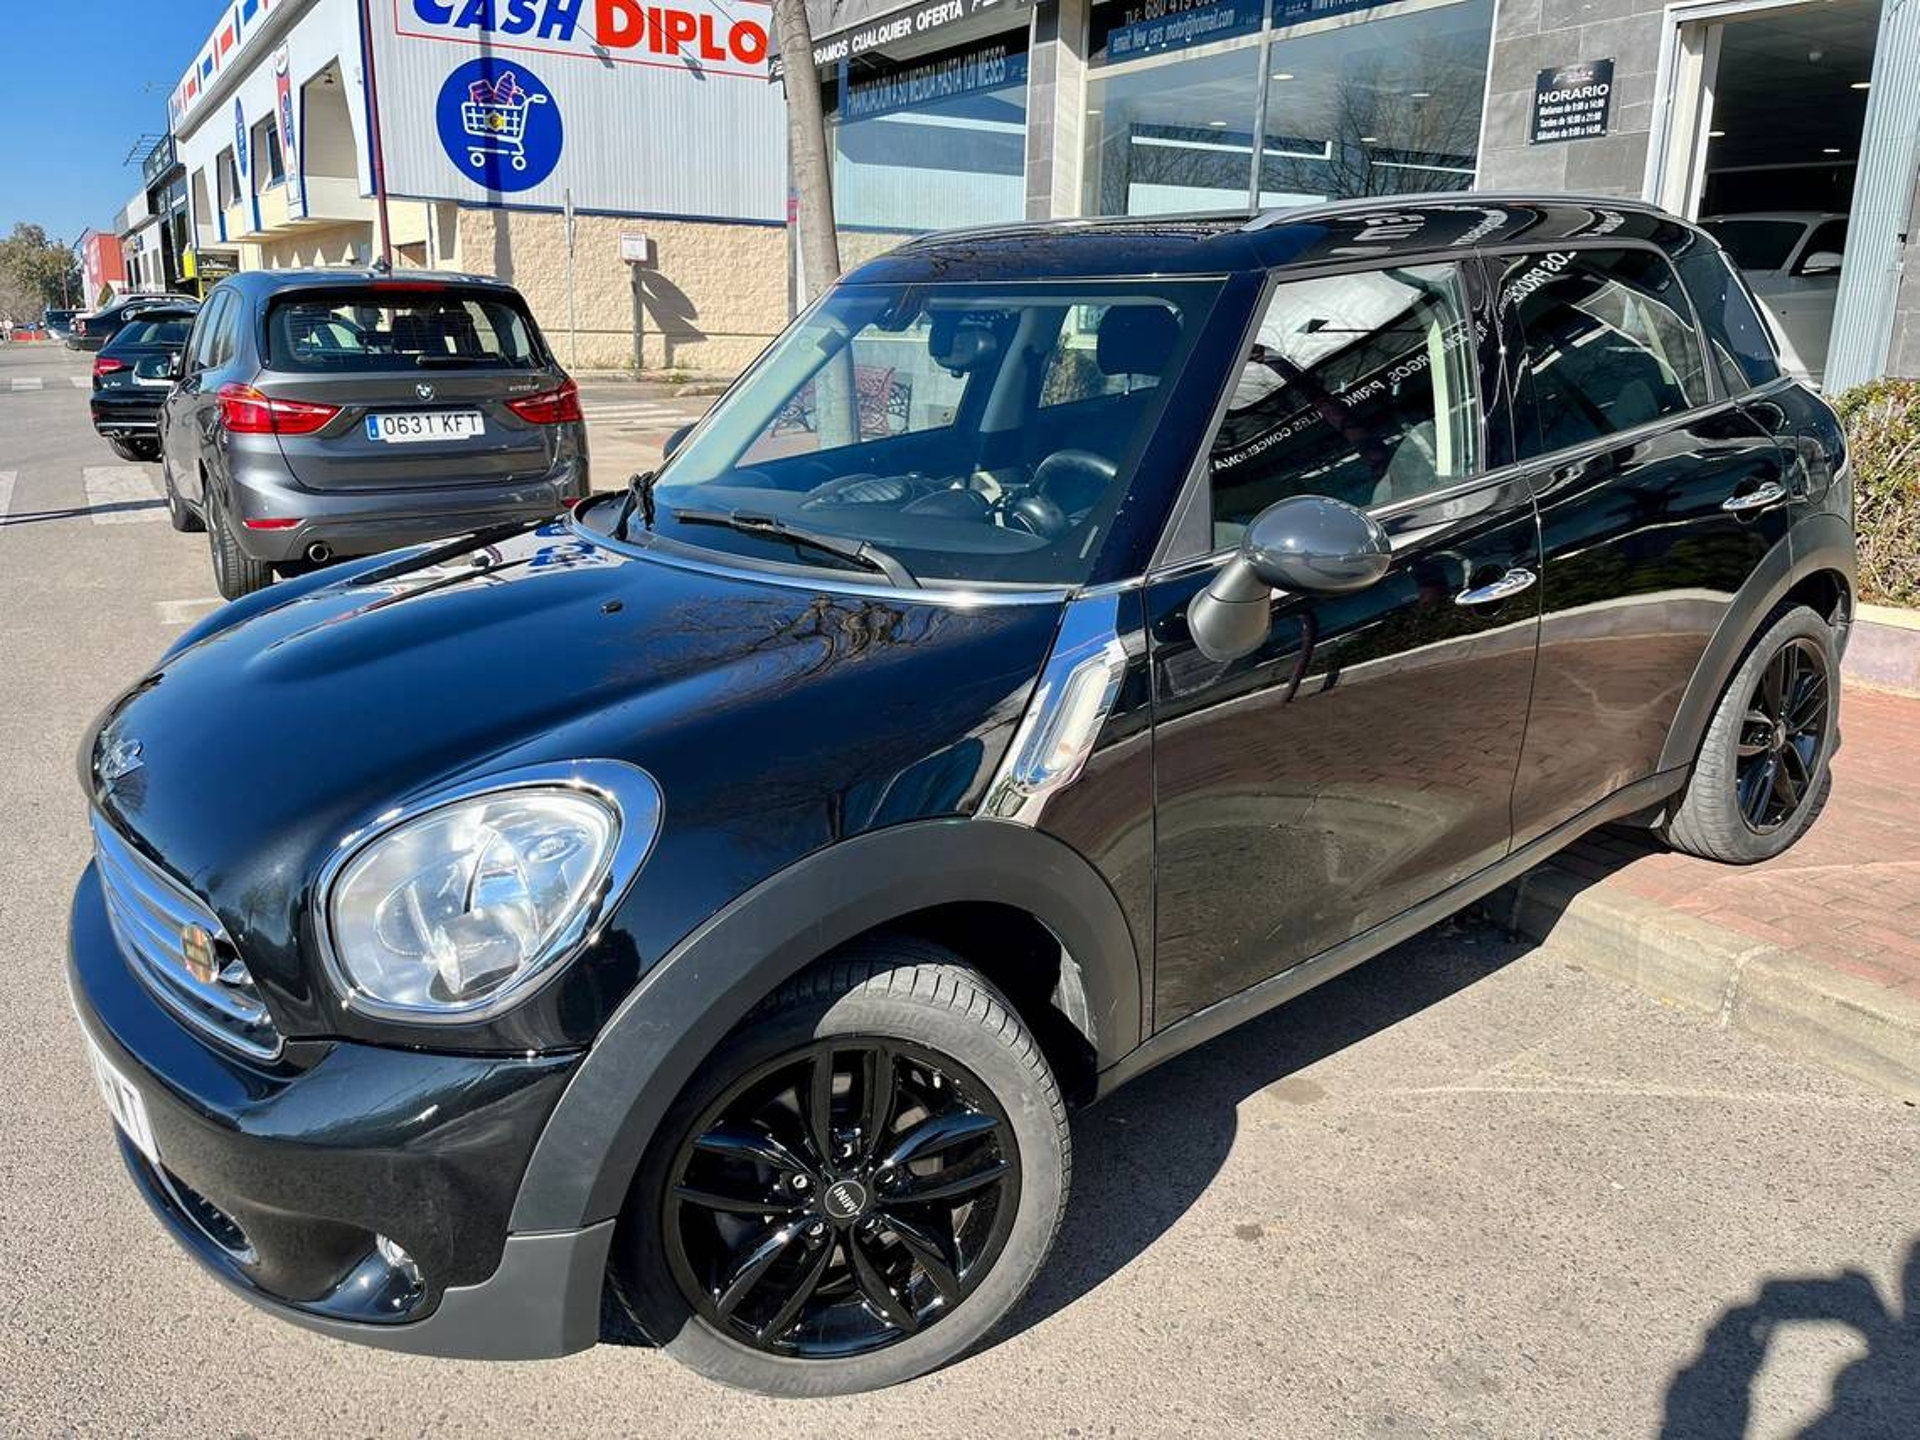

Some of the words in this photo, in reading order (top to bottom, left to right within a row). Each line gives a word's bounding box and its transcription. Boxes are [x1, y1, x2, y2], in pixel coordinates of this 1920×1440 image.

[595, 0, 768, 65] DIPLO
[812, 40, 848, 67] RAMOS
[852, 17, 912, 53] CUALQUIER
[916, 2, 964, 32] OFERTA
[1538, 84, 1610, 105] HORARIO
[383, 415, 433, 435] 0631
[441, 413, 478, 433] KFT
